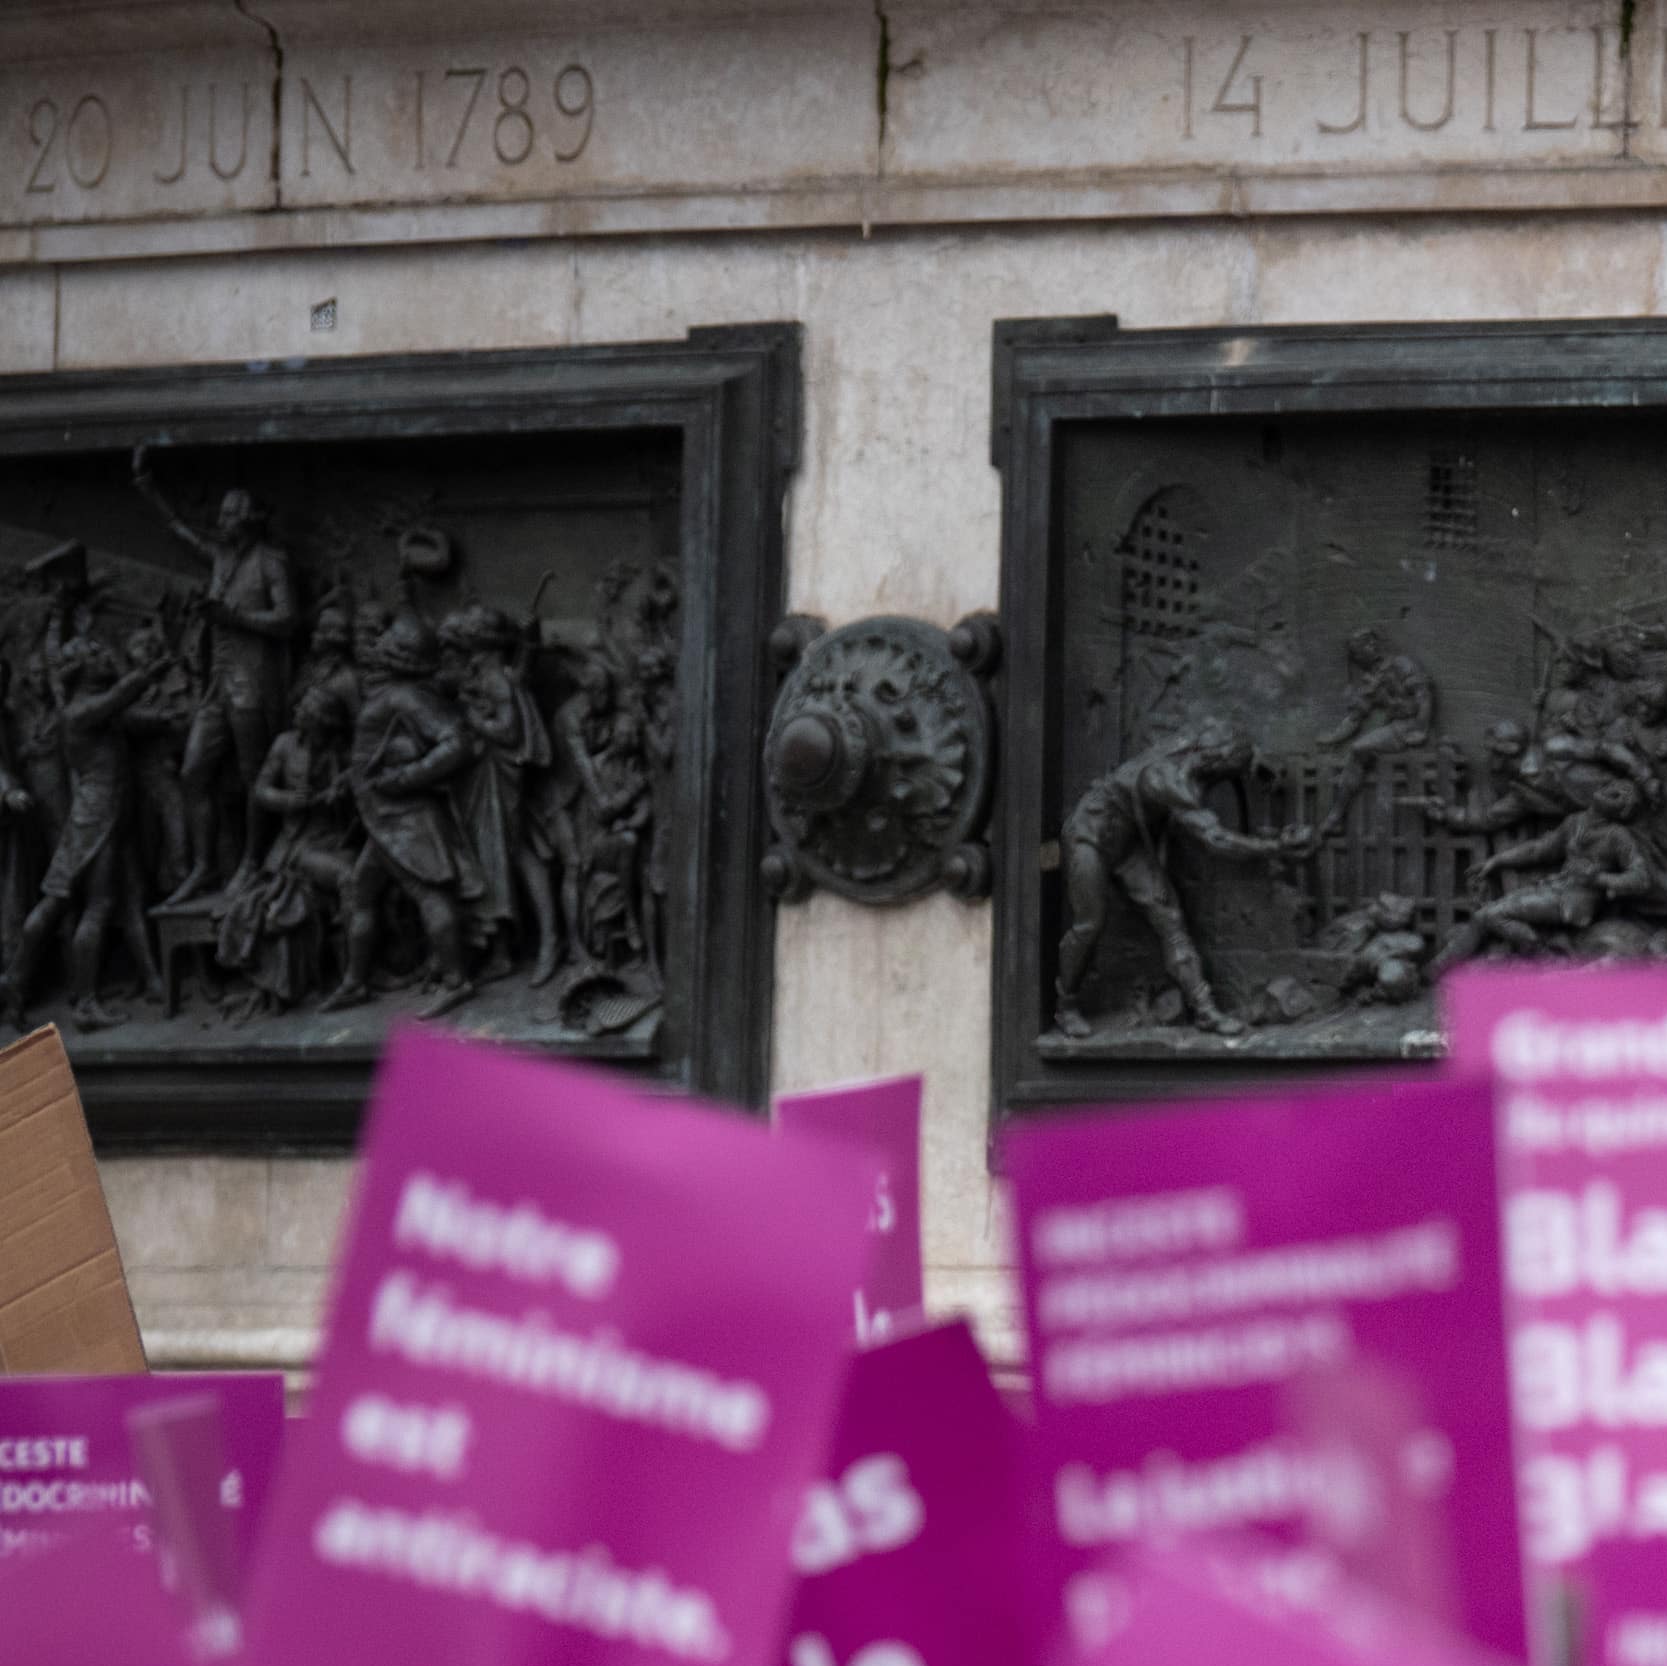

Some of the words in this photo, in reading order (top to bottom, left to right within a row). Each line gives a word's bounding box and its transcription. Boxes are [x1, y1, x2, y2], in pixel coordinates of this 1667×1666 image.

[25, 91, 113, 194] 20
[412, 64, 595, 168] 1789
[1180, 34, 1264, 138] 14
[0, 1437, 87, 1468] CESTE
[790, 1451, 926, 1574] as
